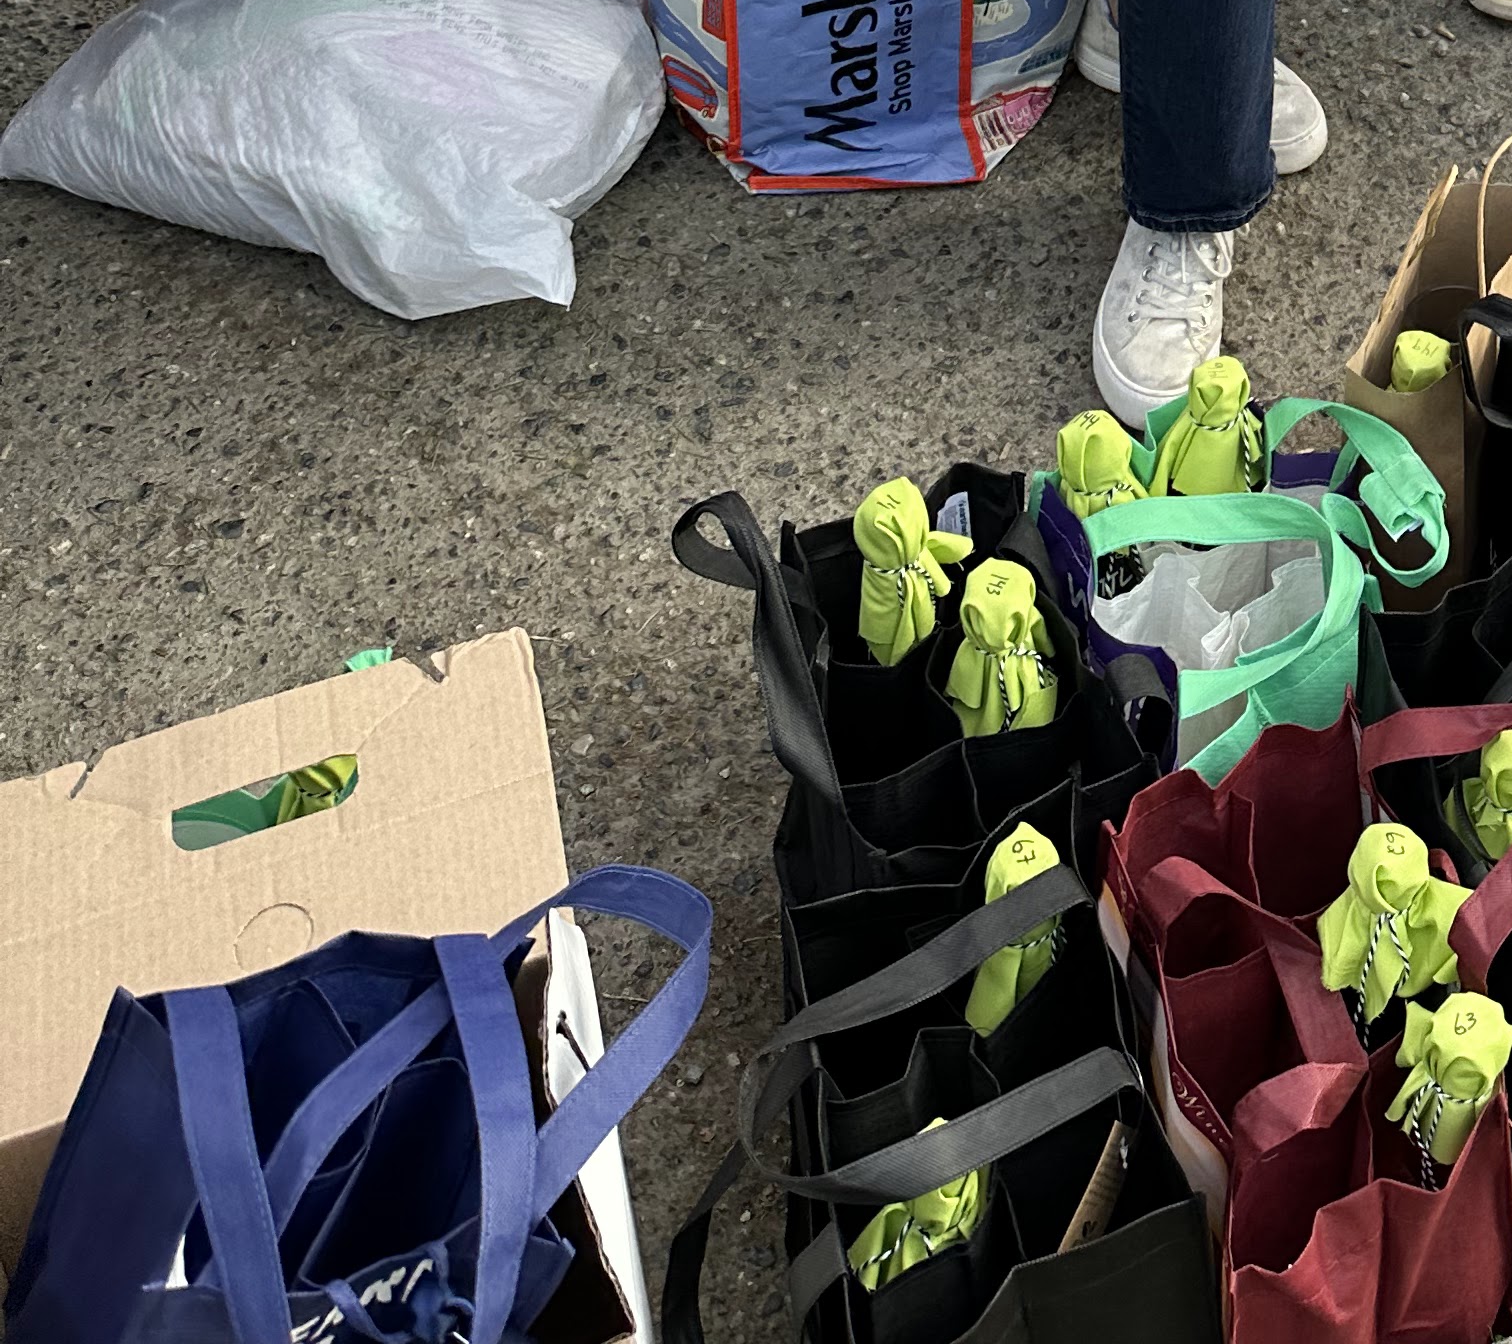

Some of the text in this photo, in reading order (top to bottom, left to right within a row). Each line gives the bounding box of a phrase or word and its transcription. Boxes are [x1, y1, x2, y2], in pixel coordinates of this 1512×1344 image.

[889, 60, 915, 115] Shop
[986, 573, 1010, 595] 143
[1454, 1012, 1478, 1035] 63
